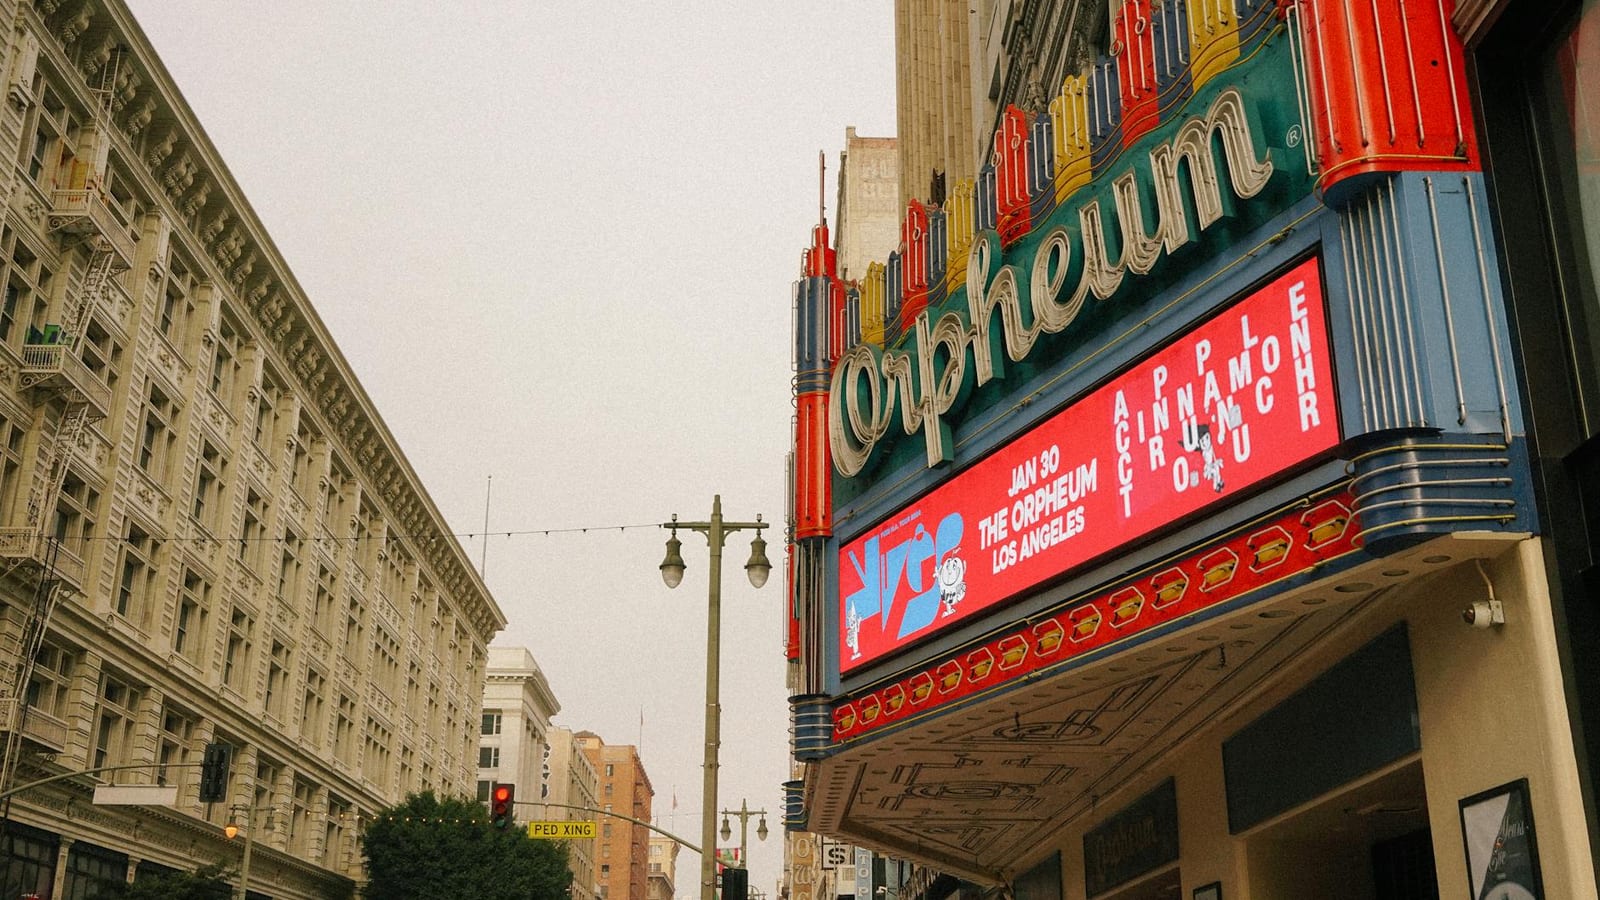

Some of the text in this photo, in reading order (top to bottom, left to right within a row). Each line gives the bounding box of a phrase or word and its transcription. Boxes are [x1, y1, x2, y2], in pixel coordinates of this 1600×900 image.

[829, 85, 1273, 478] Orpheum
[978, 506, 1009, 550] THE
[1011, 457, 1097, 532] ORPHEUM
[1008, 444, 1060, 497] JAN 30
[992, 505, 1085, 575] LOS ANGELES
[534, 824, 592, 835] PED XING
